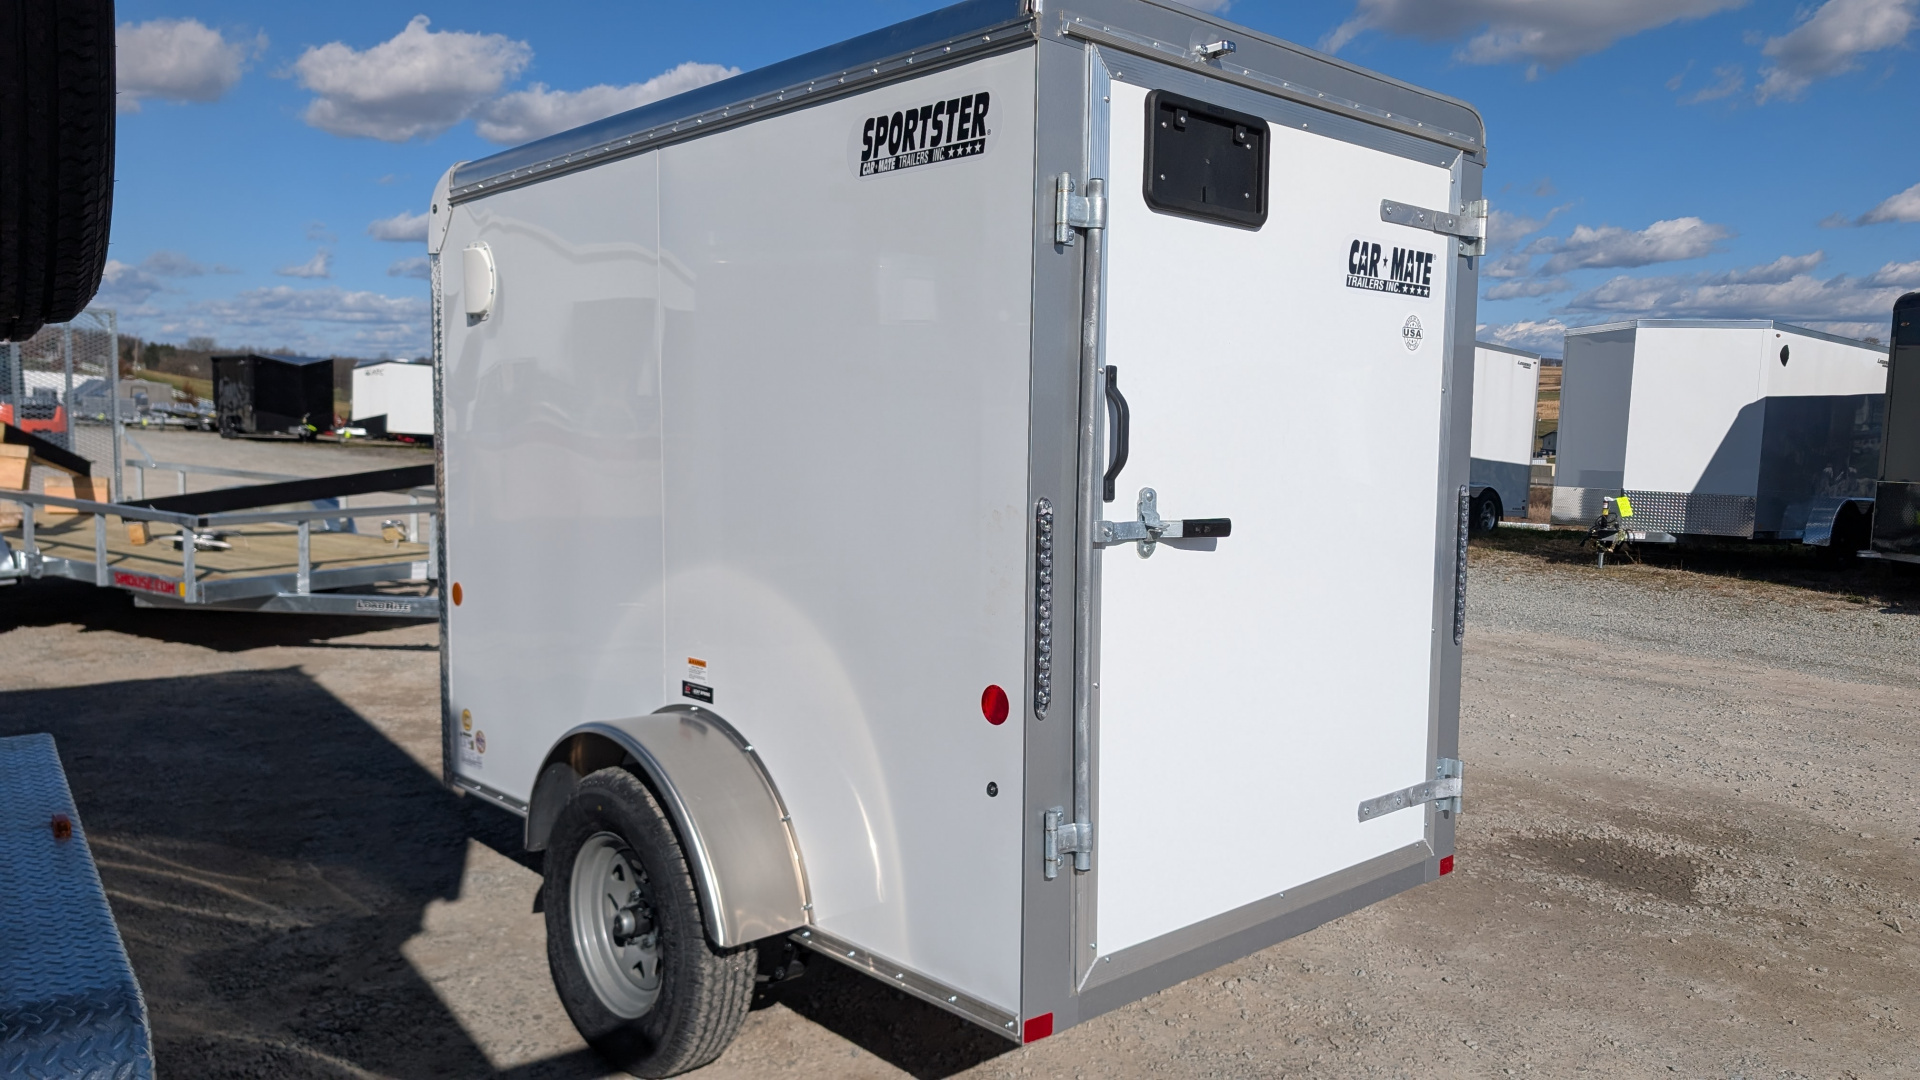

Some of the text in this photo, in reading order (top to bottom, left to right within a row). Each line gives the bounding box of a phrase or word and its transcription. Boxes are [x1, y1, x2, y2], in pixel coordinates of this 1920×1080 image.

[861, 91, 990, 162] SPORTSTER
[898, 151, 929, 169] TRAILERS
[932, 147, 945, 162] INC.
[1347, 276, 1401, 293] TRAILERS INC.
[1403, 328, 1421, 338] USA
